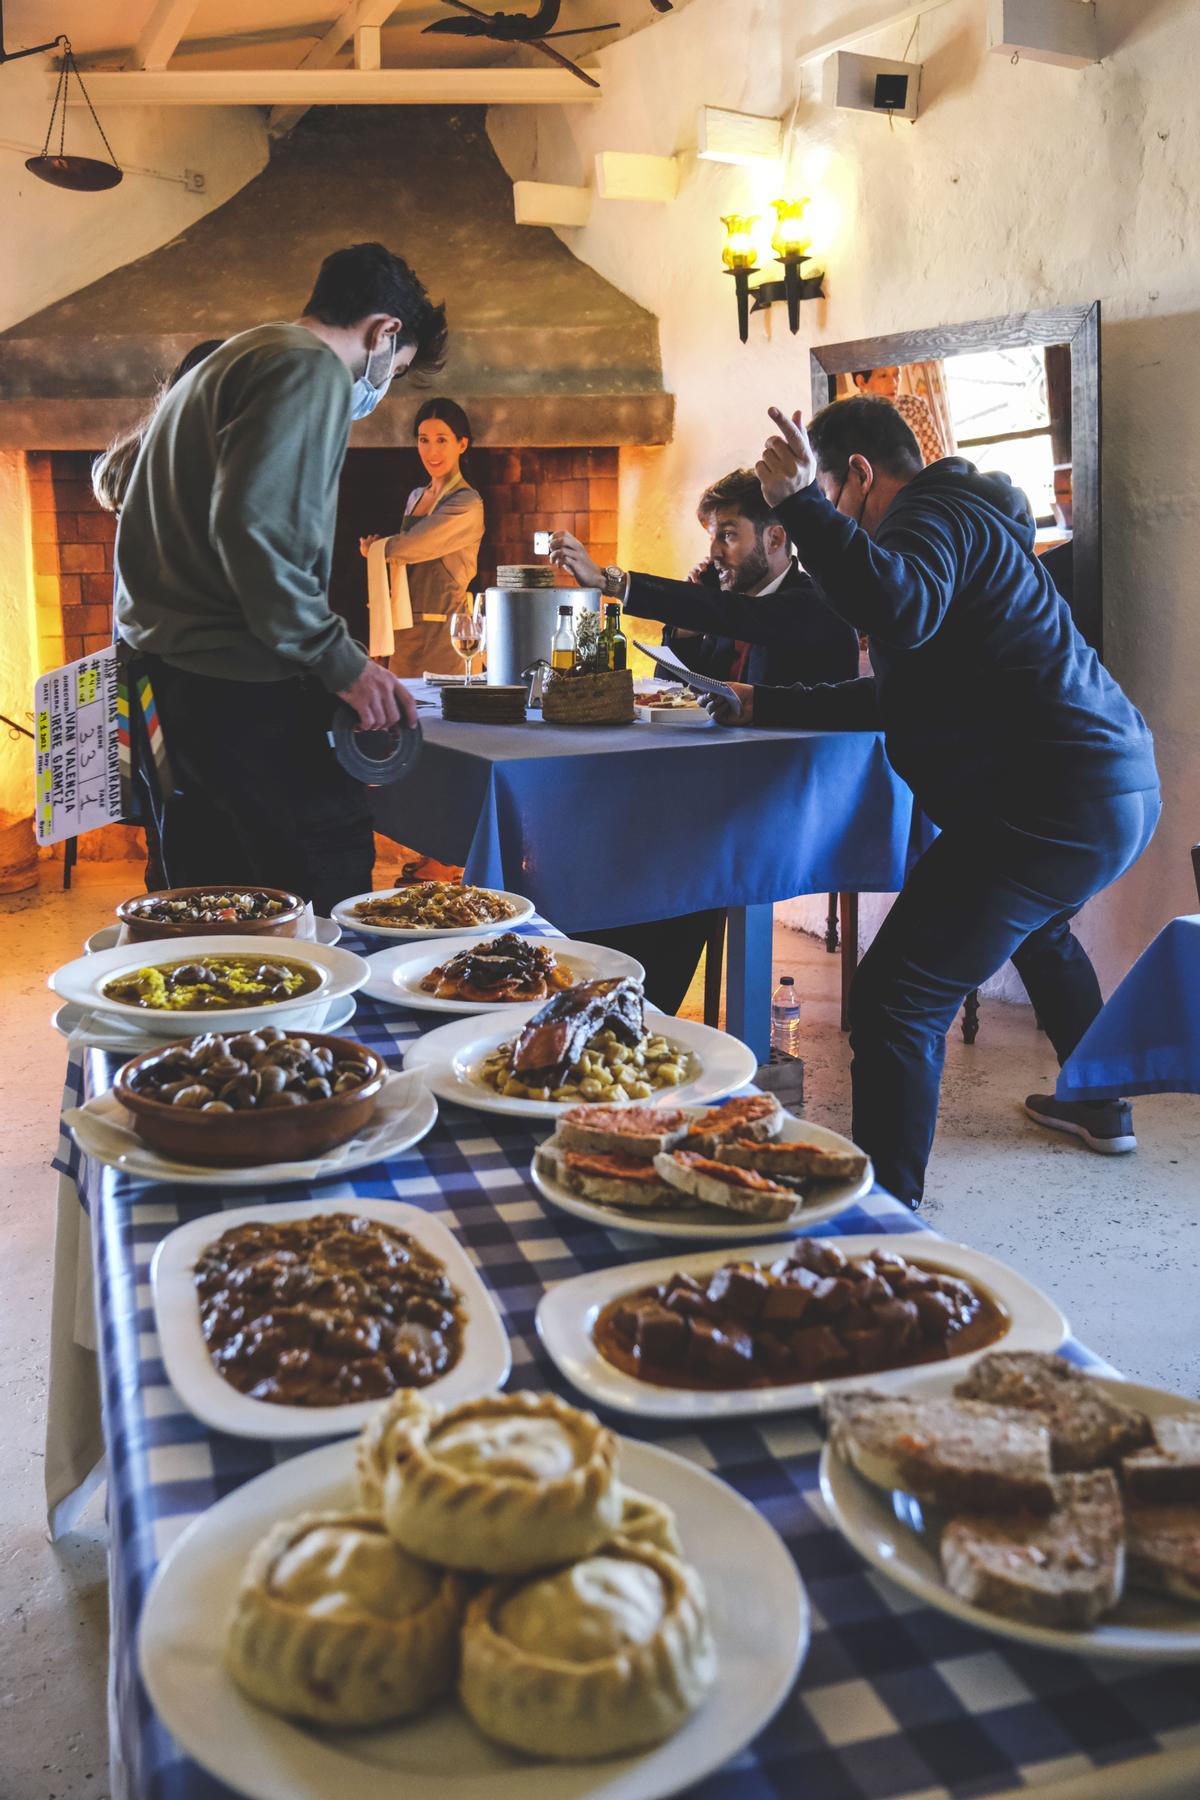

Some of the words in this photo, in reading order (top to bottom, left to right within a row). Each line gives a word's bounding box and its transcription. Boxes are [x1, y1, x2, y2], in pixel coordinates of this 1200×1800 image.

[52, 713, 62, 749] IRENE
[65, 711, 76, 741] IVAN
[65, 747, 76, 814] VALENCIA
[108, 727, 120, 817] ENCONTRADAS
